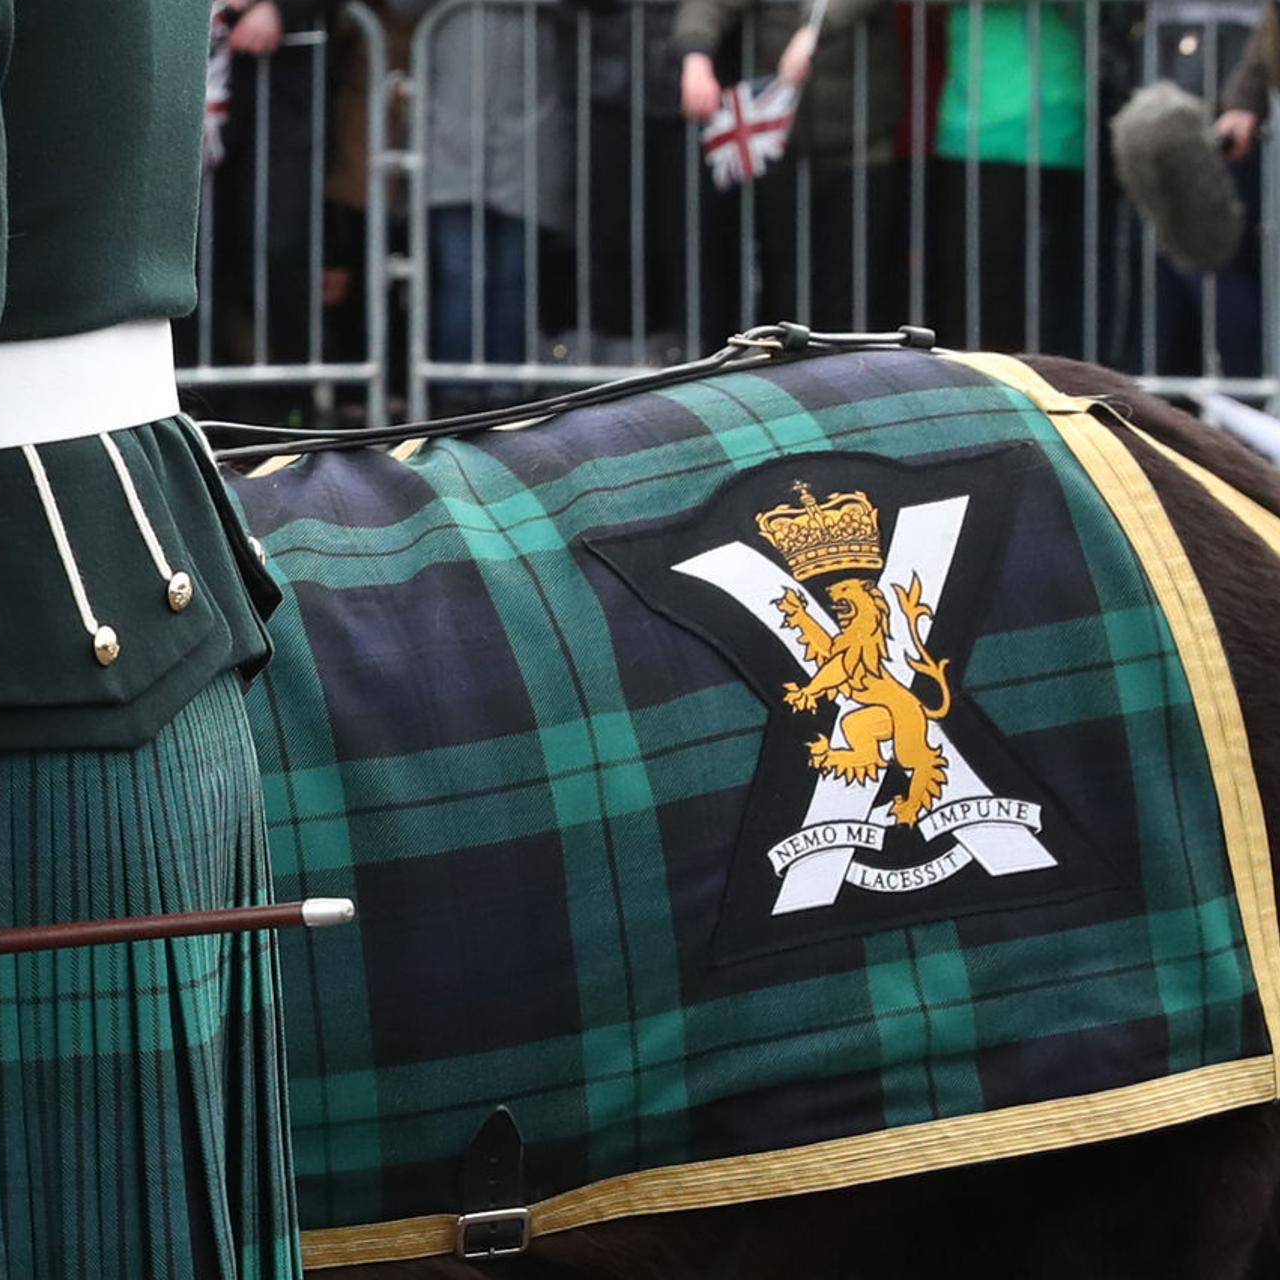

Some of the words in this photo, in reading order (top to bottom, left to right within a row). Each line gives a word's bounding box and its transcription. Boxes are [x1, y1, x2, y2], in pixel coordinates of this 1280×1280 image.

[930, 800, 1030, 831] IMPUNE
[776, 825, 837, 864] NEMO
[846, 825, 878, 846] ME
[859, 852, 959, 890] LACESSIT
